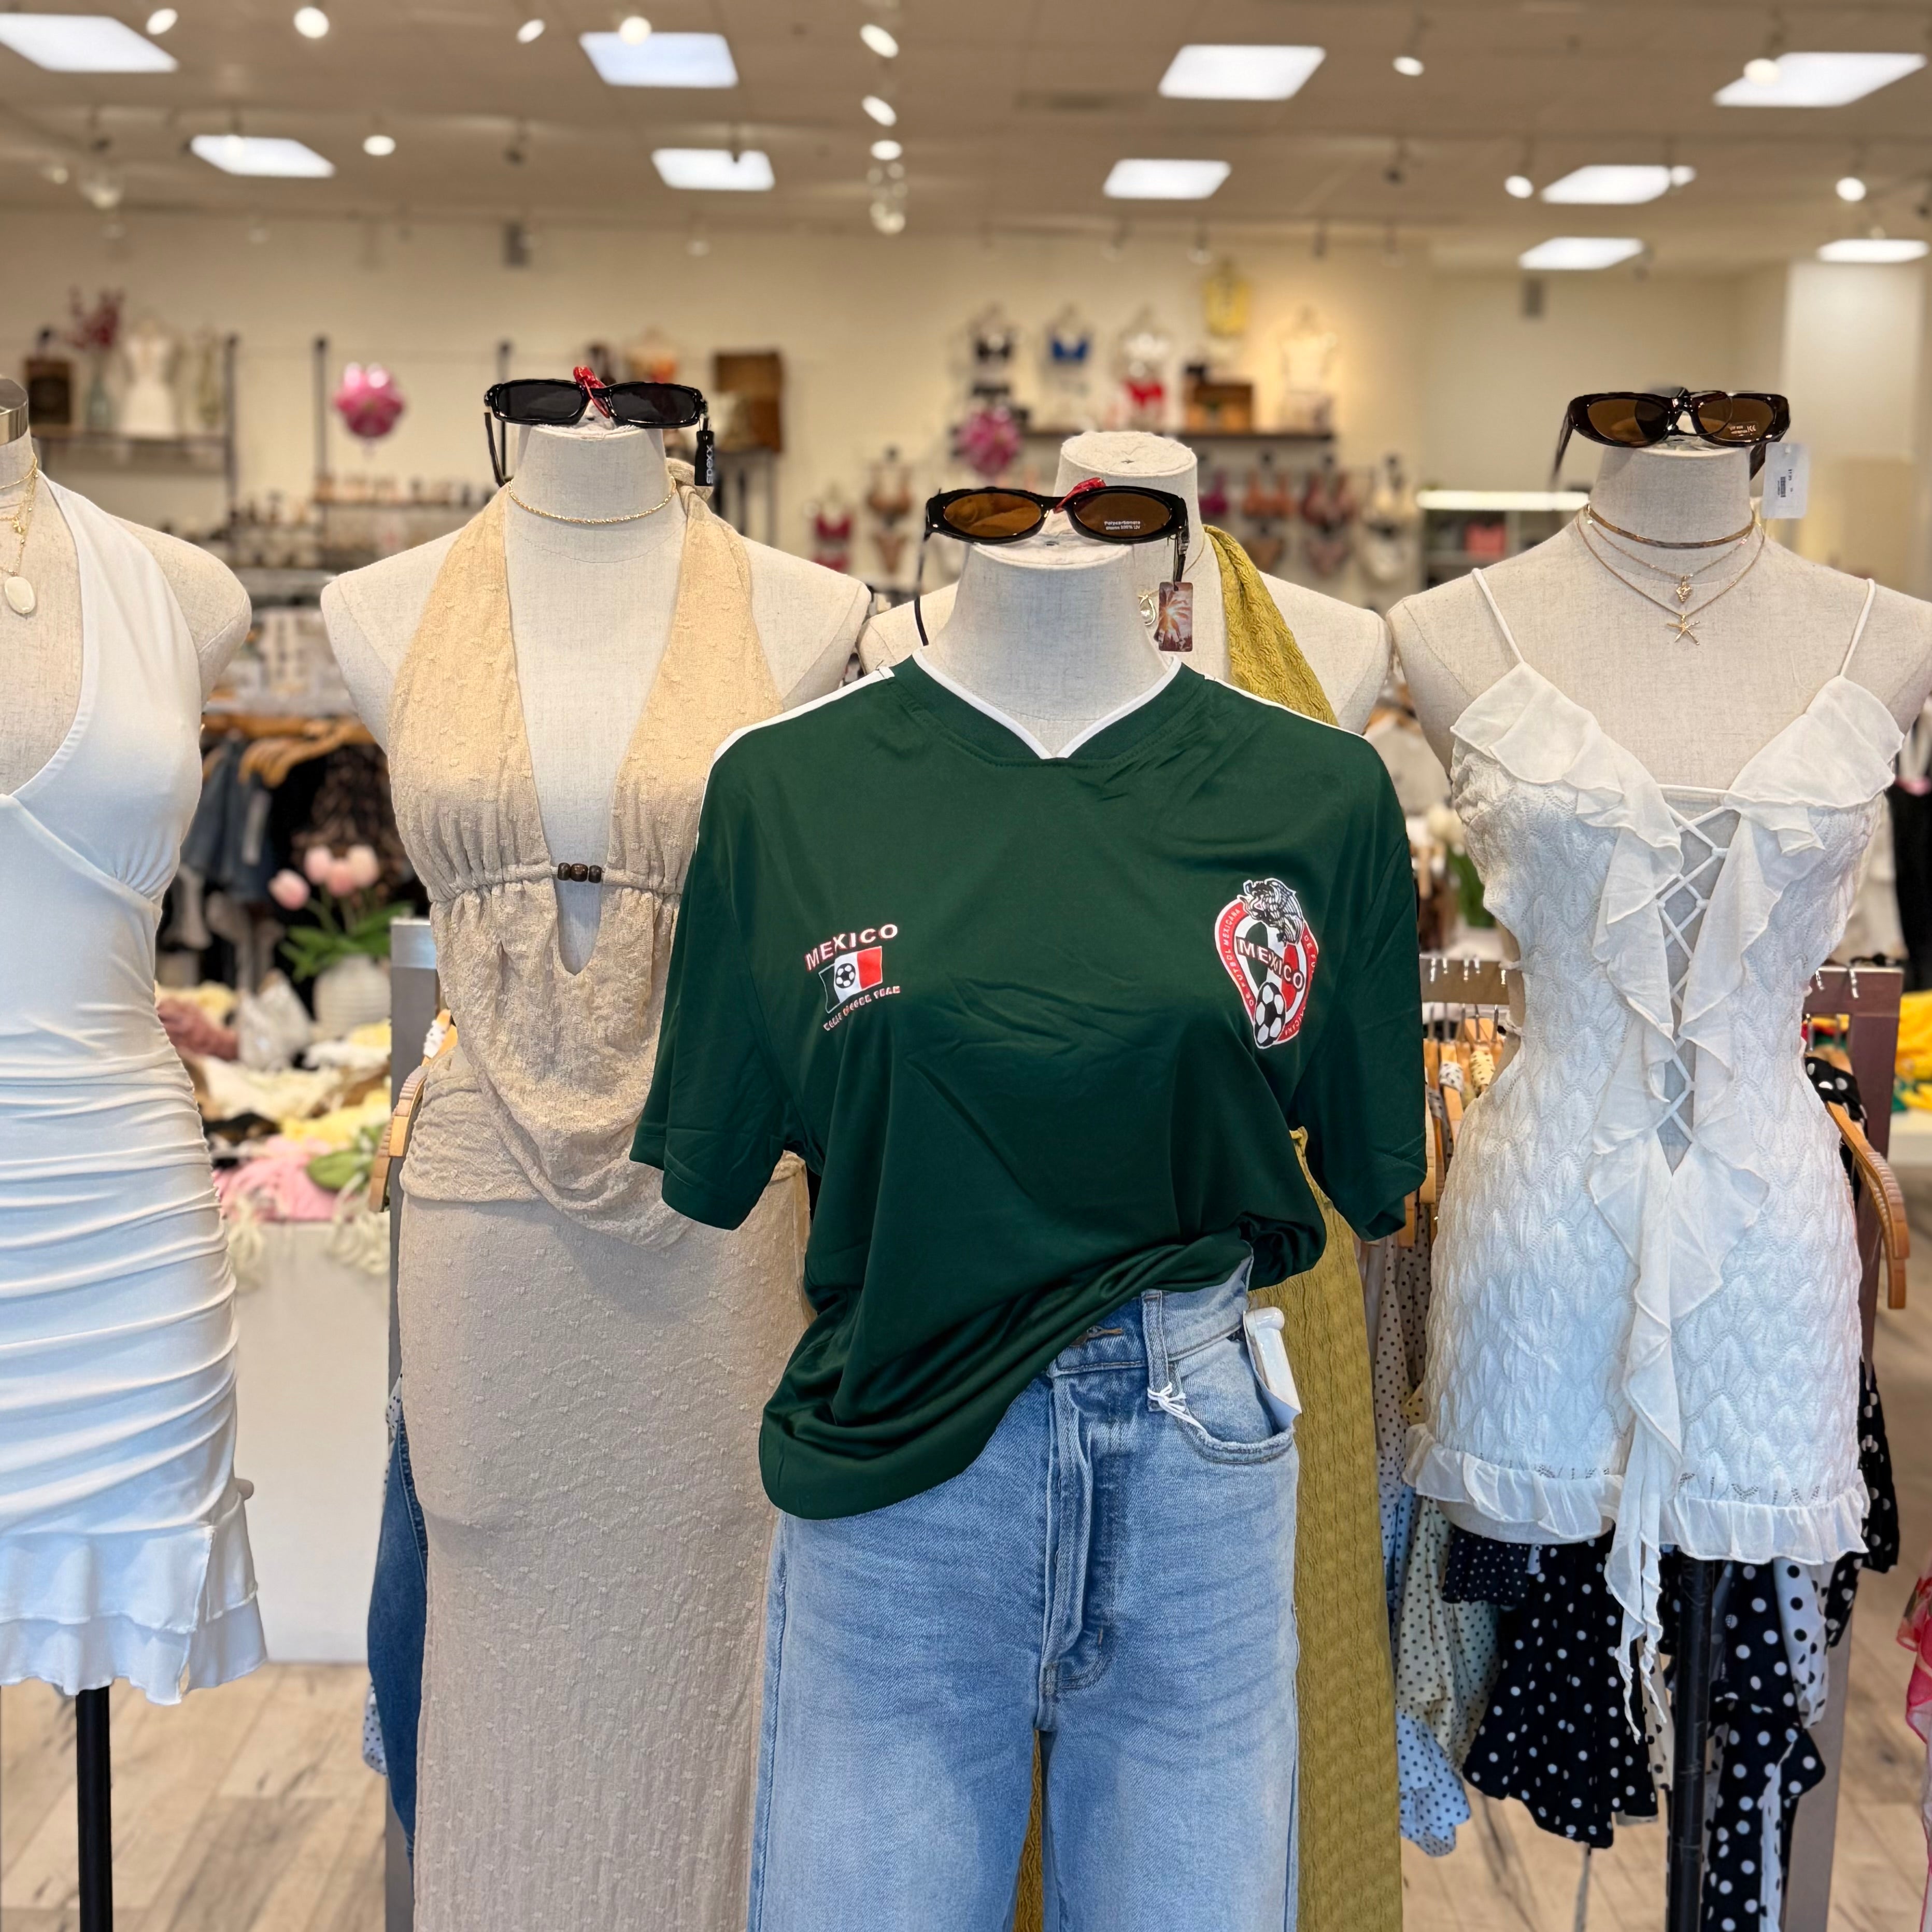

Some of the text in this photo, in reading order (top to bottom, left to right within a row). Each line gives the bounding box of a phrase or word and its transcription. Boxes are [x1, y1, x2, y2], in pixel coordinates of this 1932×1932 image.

[805, 924, 898, 972] MEXICO
[1223, 908, 1241, 948] MEXICANA
[1226, 950, 1246, 988] FUTBOL
[1239, 939, 1303, 990] MEXICO
